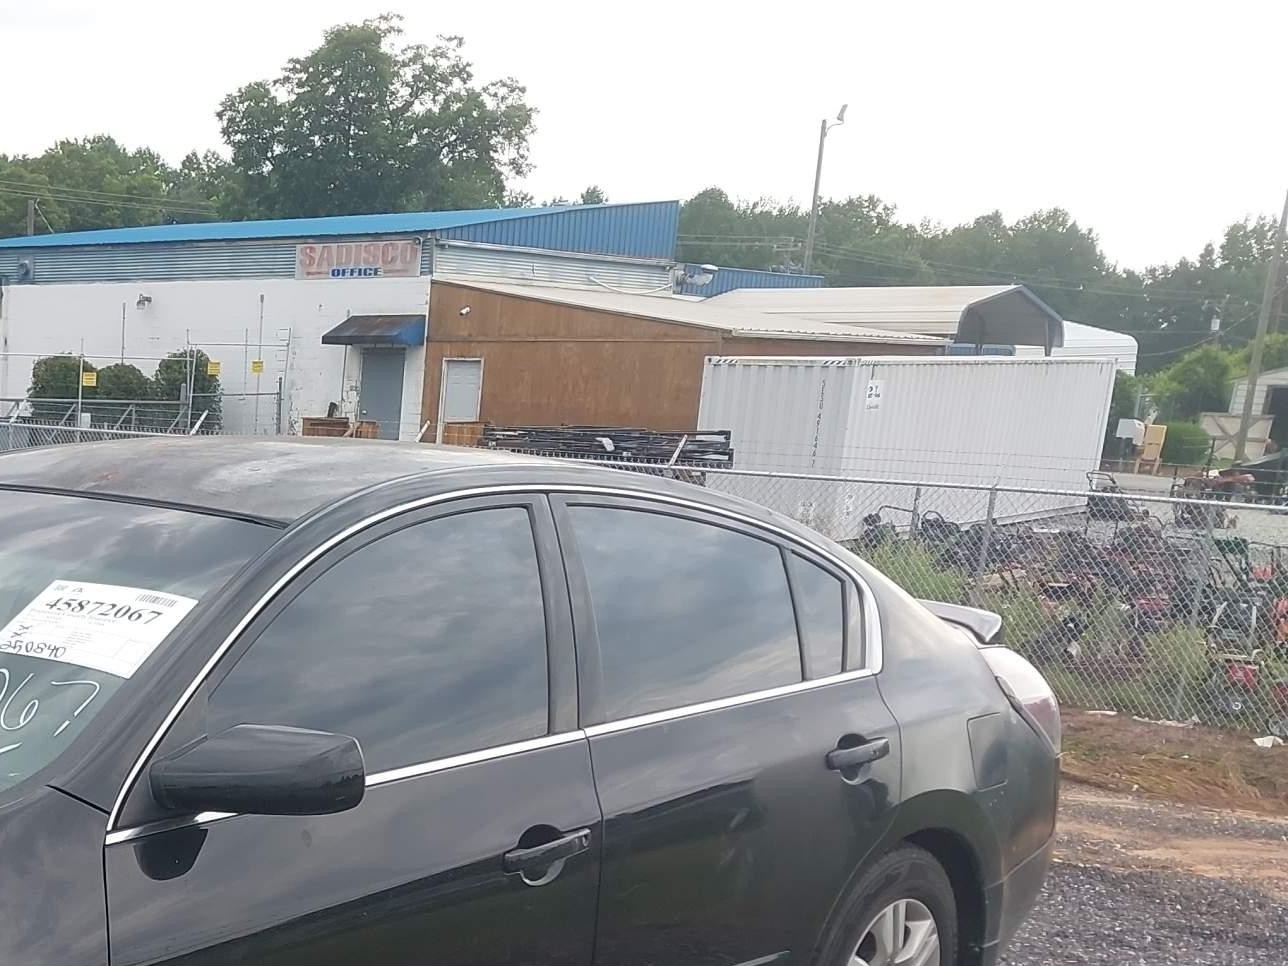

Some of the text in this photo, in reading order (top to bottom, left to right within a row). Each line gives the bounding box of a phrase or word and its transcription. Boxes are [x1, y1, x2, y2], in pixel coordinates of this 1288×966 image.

[300, 242, 418, 267] SADISCO
[331, 267, 383, 277] OFFICE
[45, 596, 163, 624] 45872067
[0, 639, 67, 659] 250840
